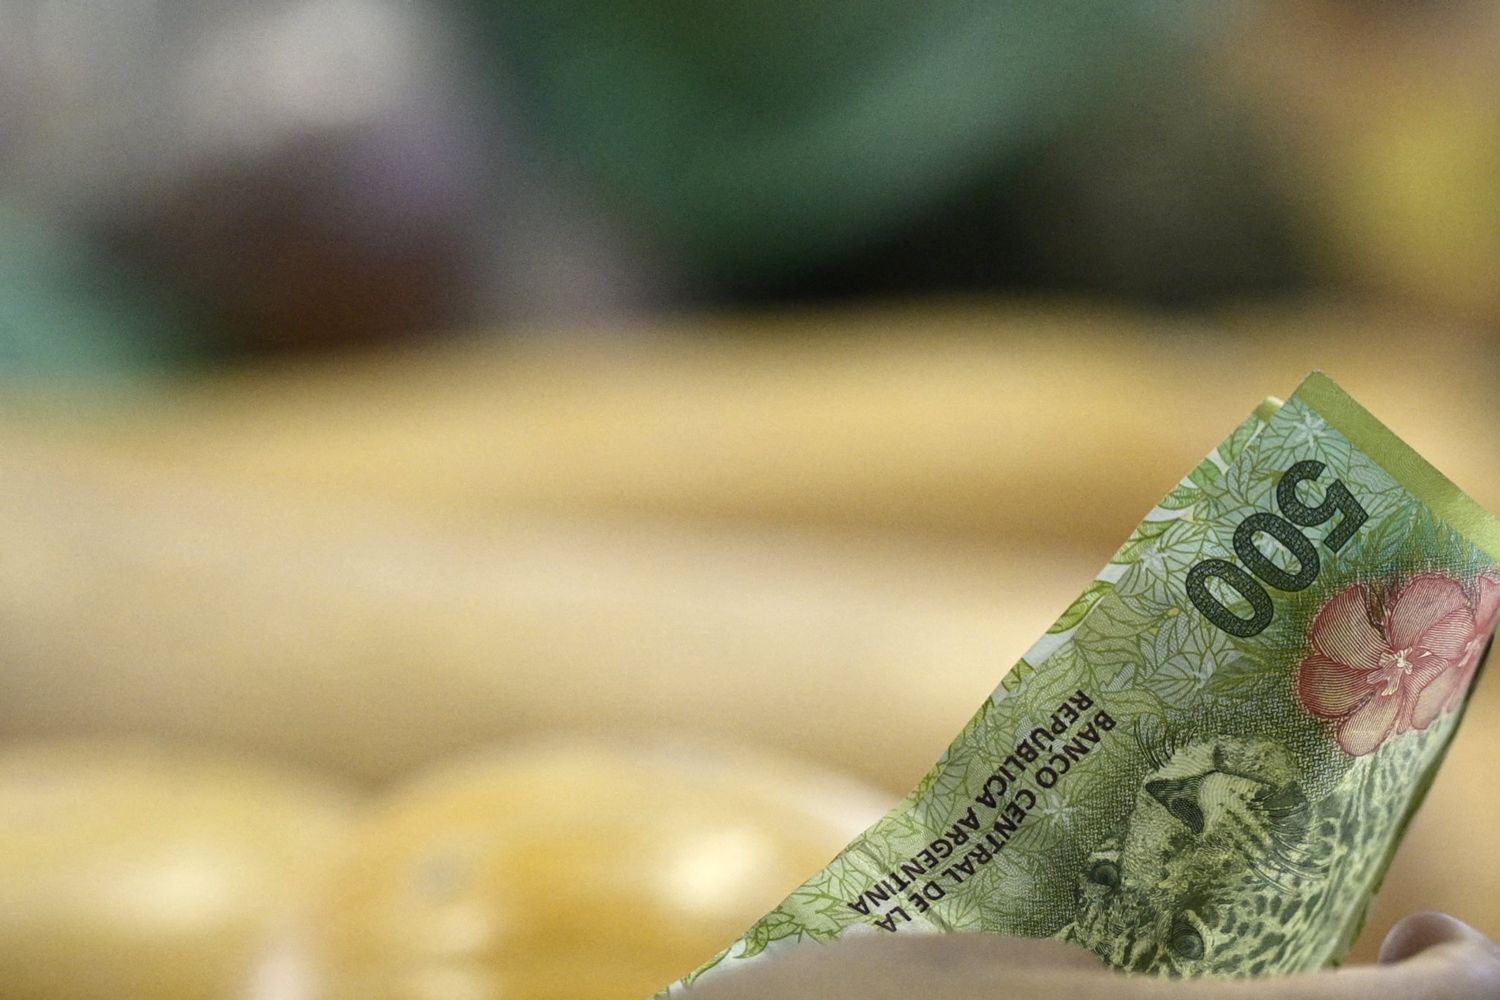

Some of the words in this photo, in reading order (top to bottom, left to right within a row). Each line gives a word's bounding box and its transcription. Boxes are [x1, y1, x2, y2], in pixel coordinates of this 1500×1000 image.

[1185, 459, 1369, 638] 500
[974, 689, 1095, 809] REPÚBLICA
[1035, 709, 1117, 788] BANCO
[847, 806, 981, 916] ARGENTINA
[942, 788, 1036, 883] CENTRAL
[874, 905, 912, 933] LA
[907, 880, 946, 913] DE
